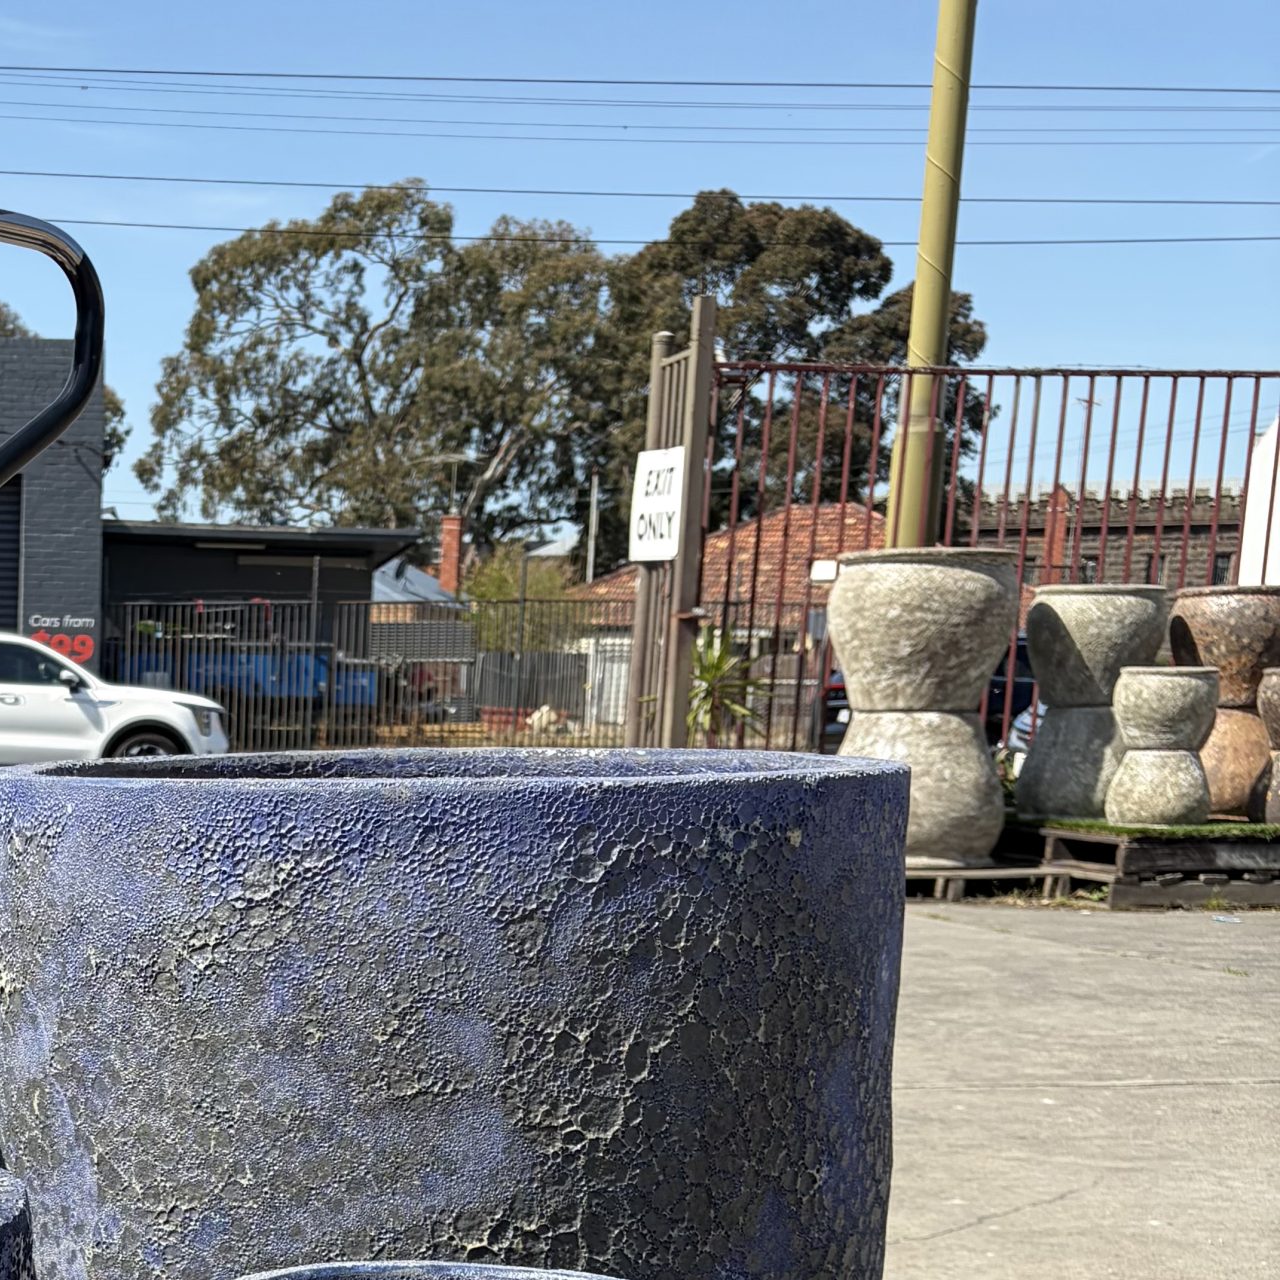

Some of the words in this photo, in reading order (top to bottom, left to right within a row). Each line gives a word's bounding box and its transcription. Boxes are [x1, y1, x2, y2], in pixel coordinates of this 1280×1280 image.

[644, 467, 675, 497] EXIT
[636, 511, 676, 541] ONLY
[29, 614, 61, 628] Cars
[62, 614, 95, 628] from
